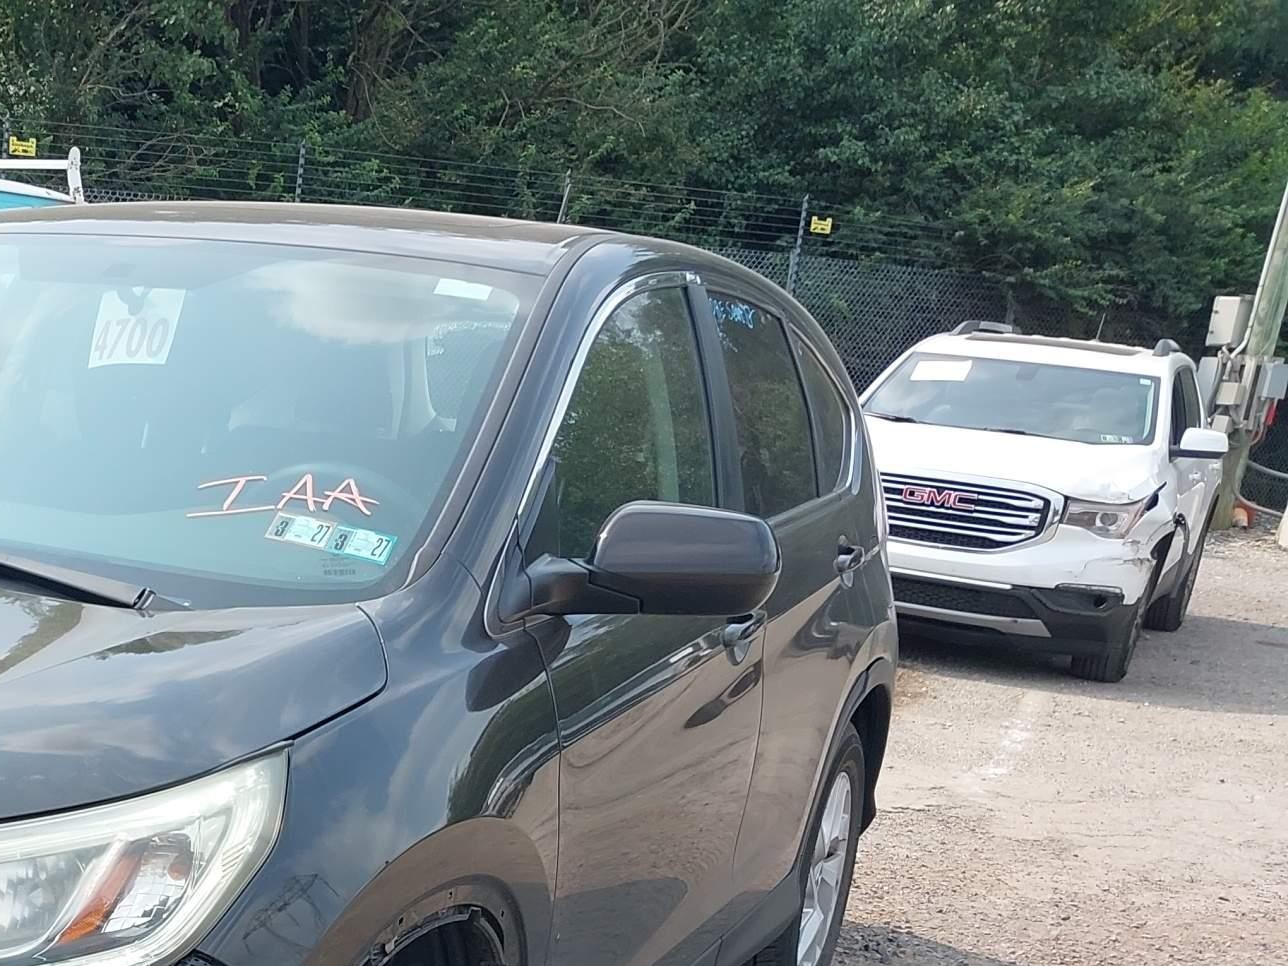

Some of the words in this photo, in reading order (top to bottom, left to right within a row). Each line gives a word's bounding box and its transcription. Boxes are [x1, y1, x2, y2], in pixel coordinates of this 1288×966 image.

[94, 317, 170, 361] 4700
[186, 474, 380, 515] IAA
[903, 486, 977, 510] GMC
[275, 520, 289, 537] 3
[311, 524, 330, 545] 27
[334, 533, 348, 550] 3
[371, 537, 390, 557] 27
